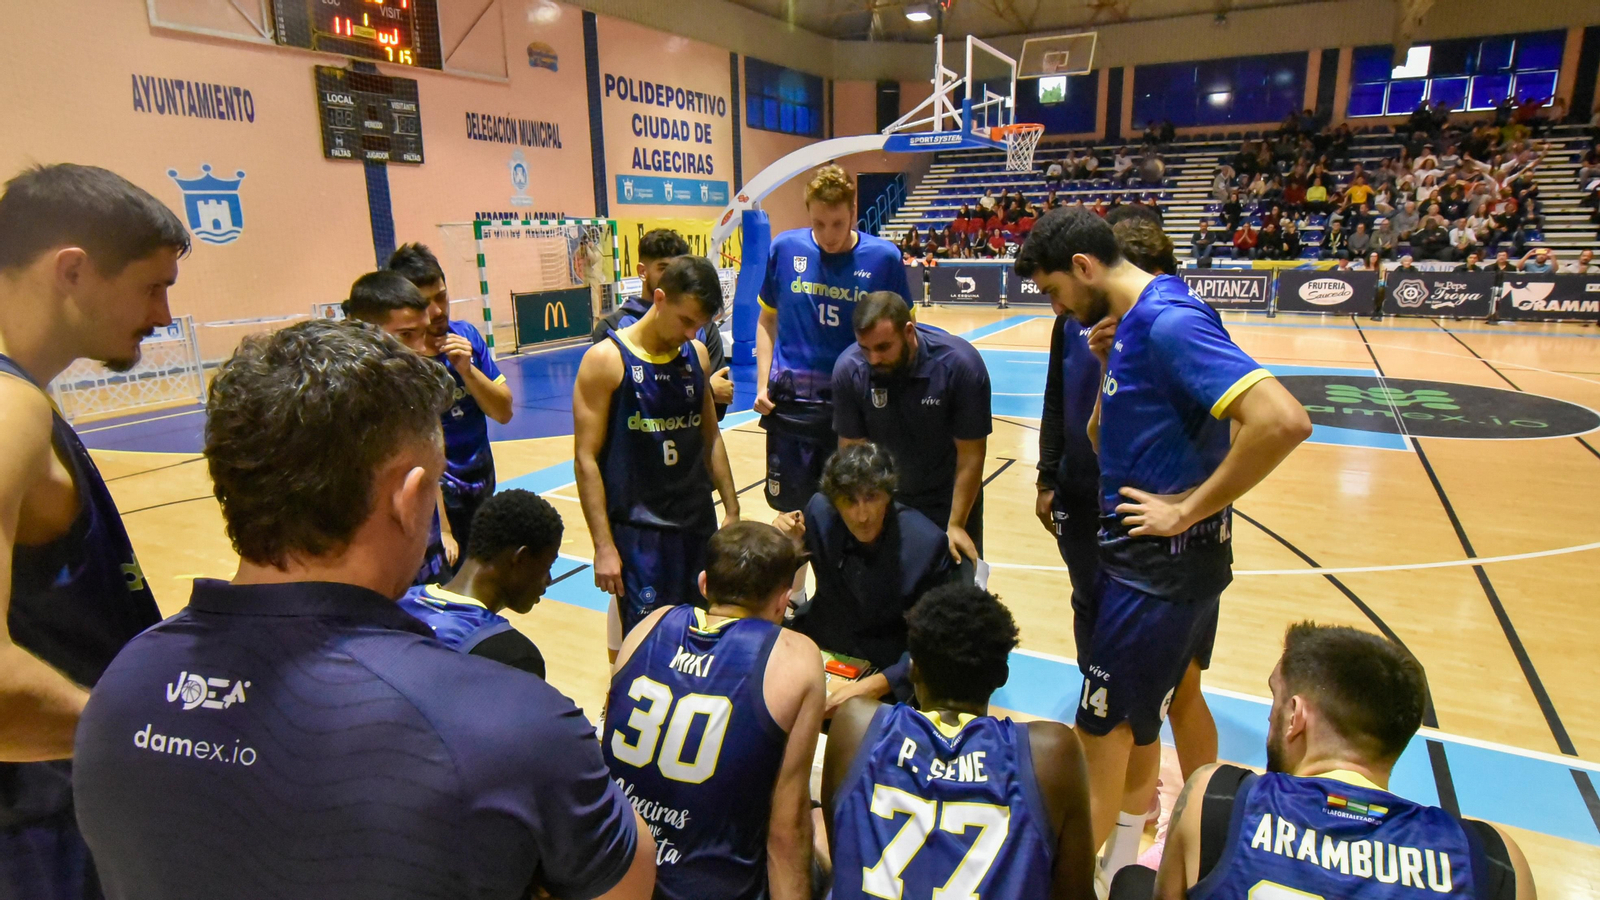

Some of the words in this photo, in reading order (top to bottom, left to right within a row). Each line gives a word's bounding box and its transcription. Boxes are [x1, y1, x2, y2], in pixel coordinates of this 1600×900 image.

[131, 73, 255, 123] AYUNTAMIENTO
[326, 93, 354, 105] LOCAL
[604, 73, 726, 118] POLIDEPORTIVO
[465, 111, 518, 146] DELEGACIÓN
[518, 118, 562, 149] MUNICIPAL
[631, 113, 690, 142] CIUDAD
[694, 121, 713, 145] DE
[933, 134, 963, 144] SYSTEM
[331, 149, 351, 158] FALTAS
[631, 147, 714, 175] ALGECIRAS
[853, 269, 872, 279] vive
[1307, 281, 1346, 290] FRUTERIA
[1445, 281, 1468, 291] Pepe
[790, 275, 869, 302] damex.io
[1430, 287, 1484, 305] Troya
[818, 303, 840, 327] 15
[921, 396, 941, 406] vive
[627, 411, 702, 433] damex.io
[1303, 405, 1549, 428] amex.io
[662, 440, 679, 466] 6
[669, 645, 715, 678] MIKI
[1089, 664, 1111, 682] vive
[1081, 678, 1109, 718] 14
[610, 675, 733, 784] 30
[133, 723, 257, 766] damex.io
[897, 736, 919, 774] P.
[926, 751, 988, 782] SENE
[862, 783, 1011, 900] 77
[1250, 813, 1453, 893] ARAMBURU
